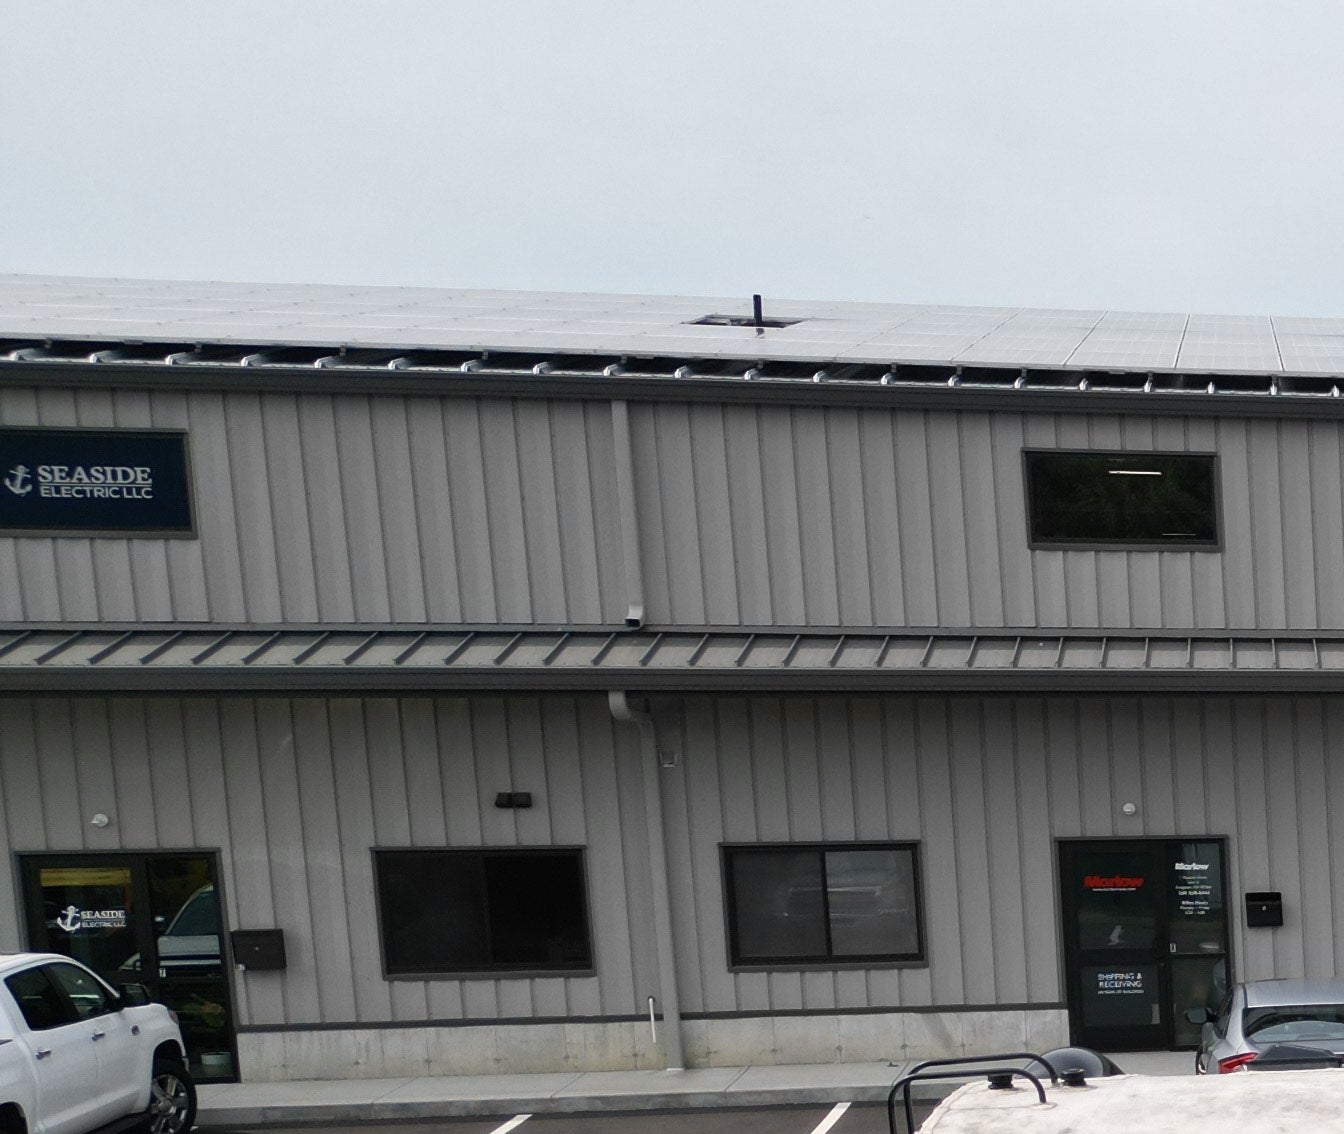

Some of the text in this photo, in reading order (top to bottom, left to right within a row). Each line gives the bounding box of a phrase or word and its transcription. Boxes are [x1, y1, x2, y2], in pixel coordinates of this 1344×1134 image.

[37, 465, 153, 484] SEASIDE
[40, 486, 153, 499] ELECTRIC LLC
[81, 910, 126, 919] SEASIDE
